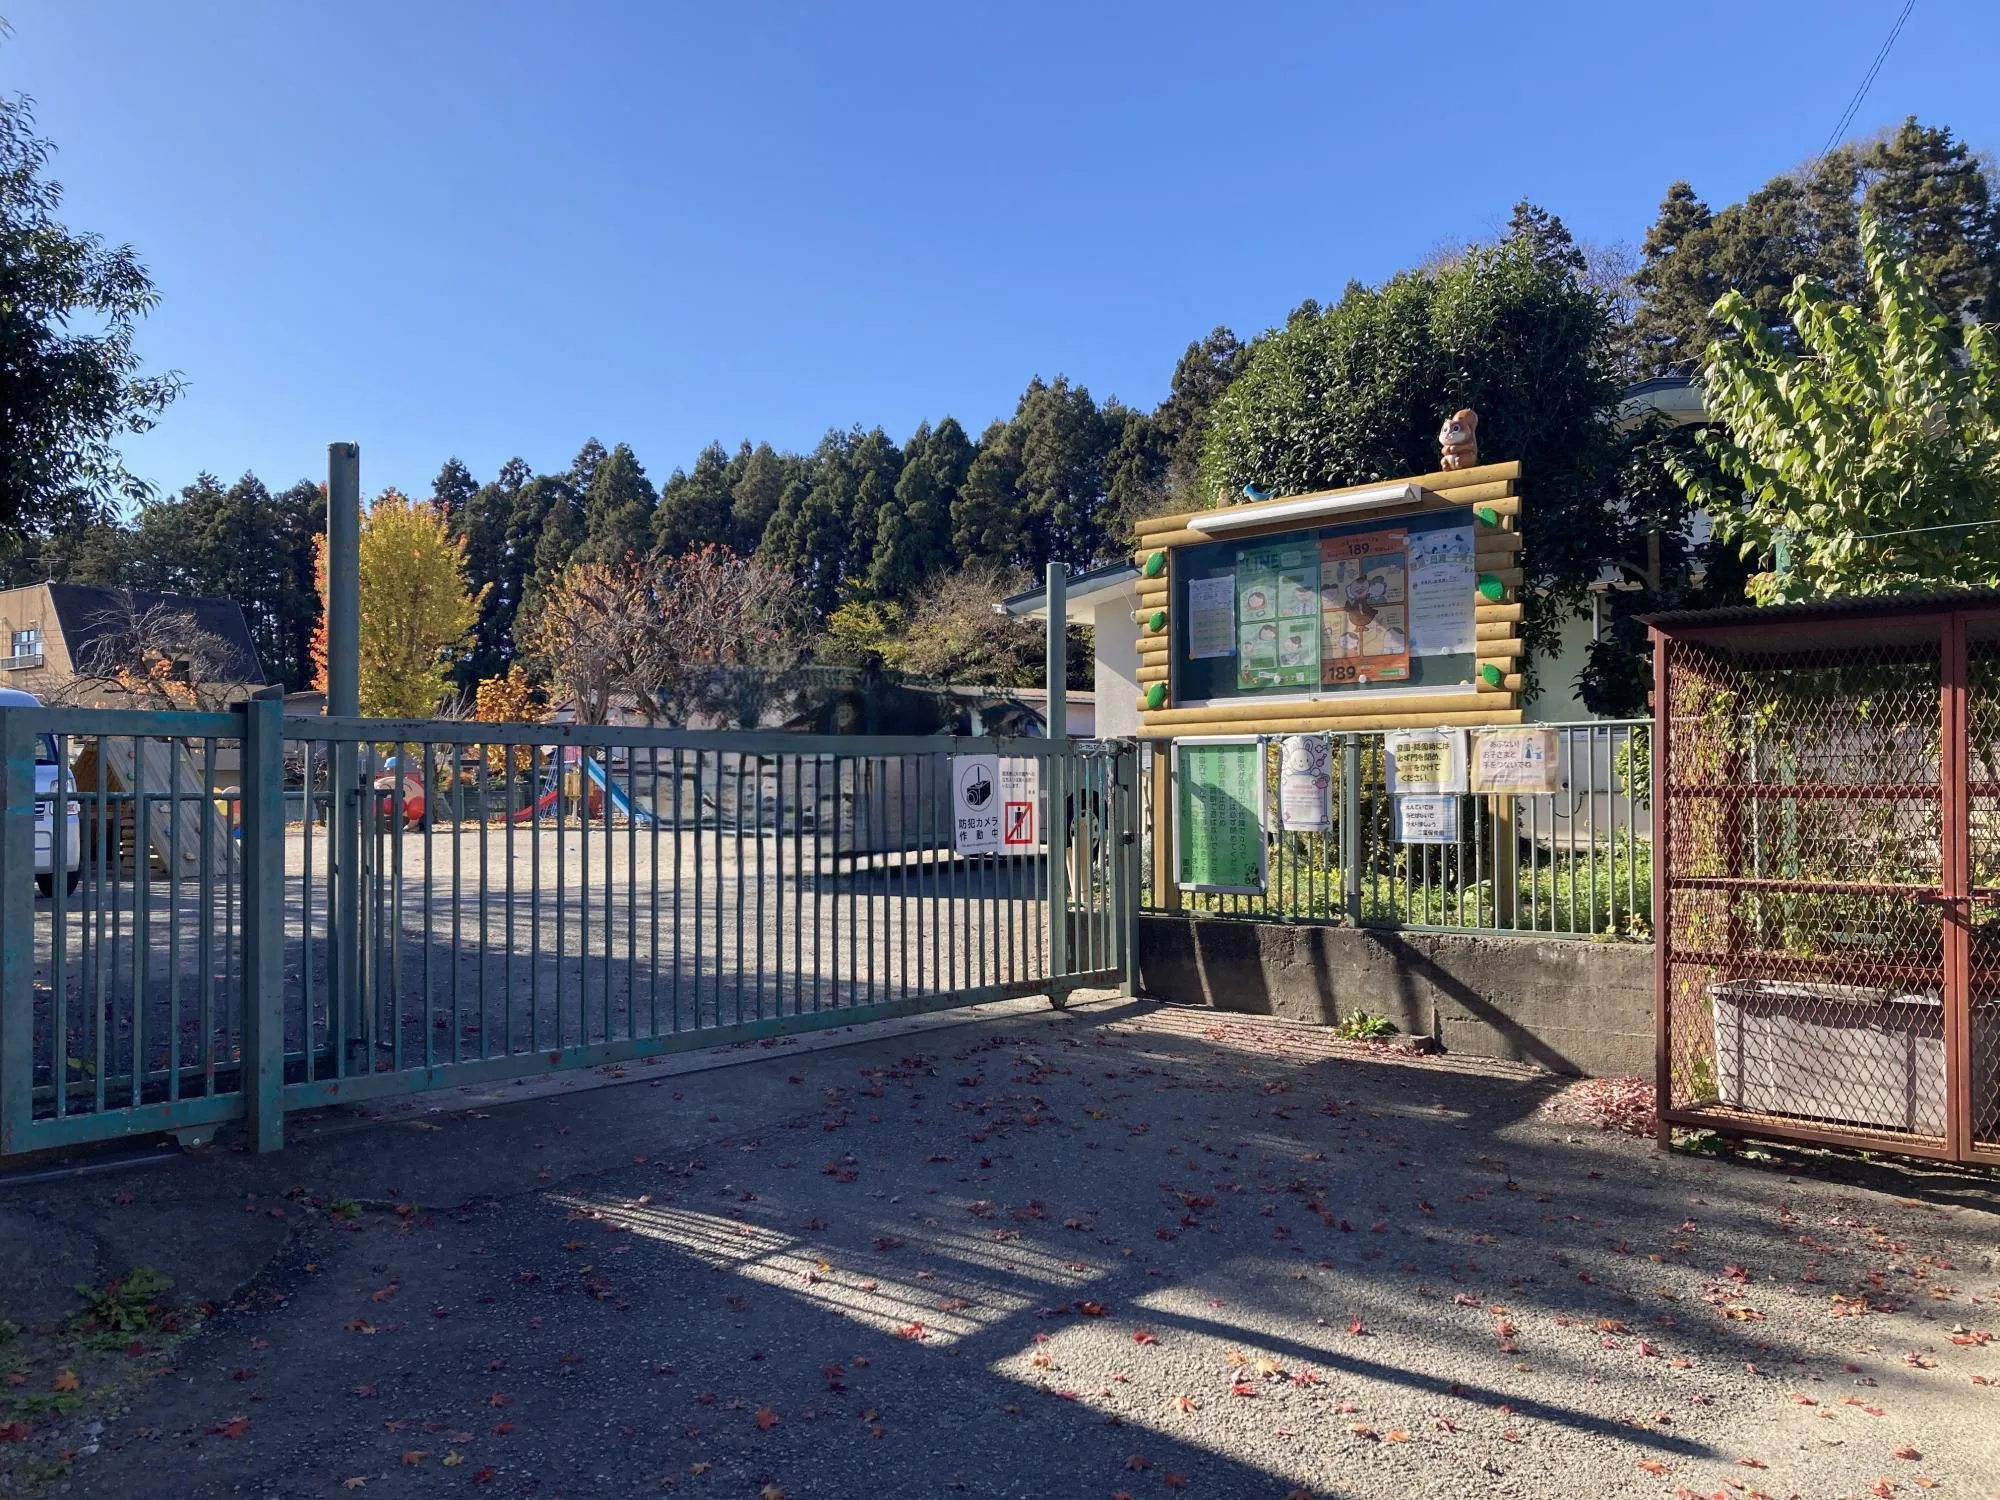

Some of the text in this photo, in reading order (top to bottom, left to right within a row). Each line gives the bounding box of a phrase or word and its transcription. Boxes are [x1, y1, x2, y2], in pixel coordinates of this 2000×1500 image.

[1349, 543, 1370, 556] 189
[1329, 665, 1356, 681] 189
[958, 816, 998, 829] 防犯カメラ
